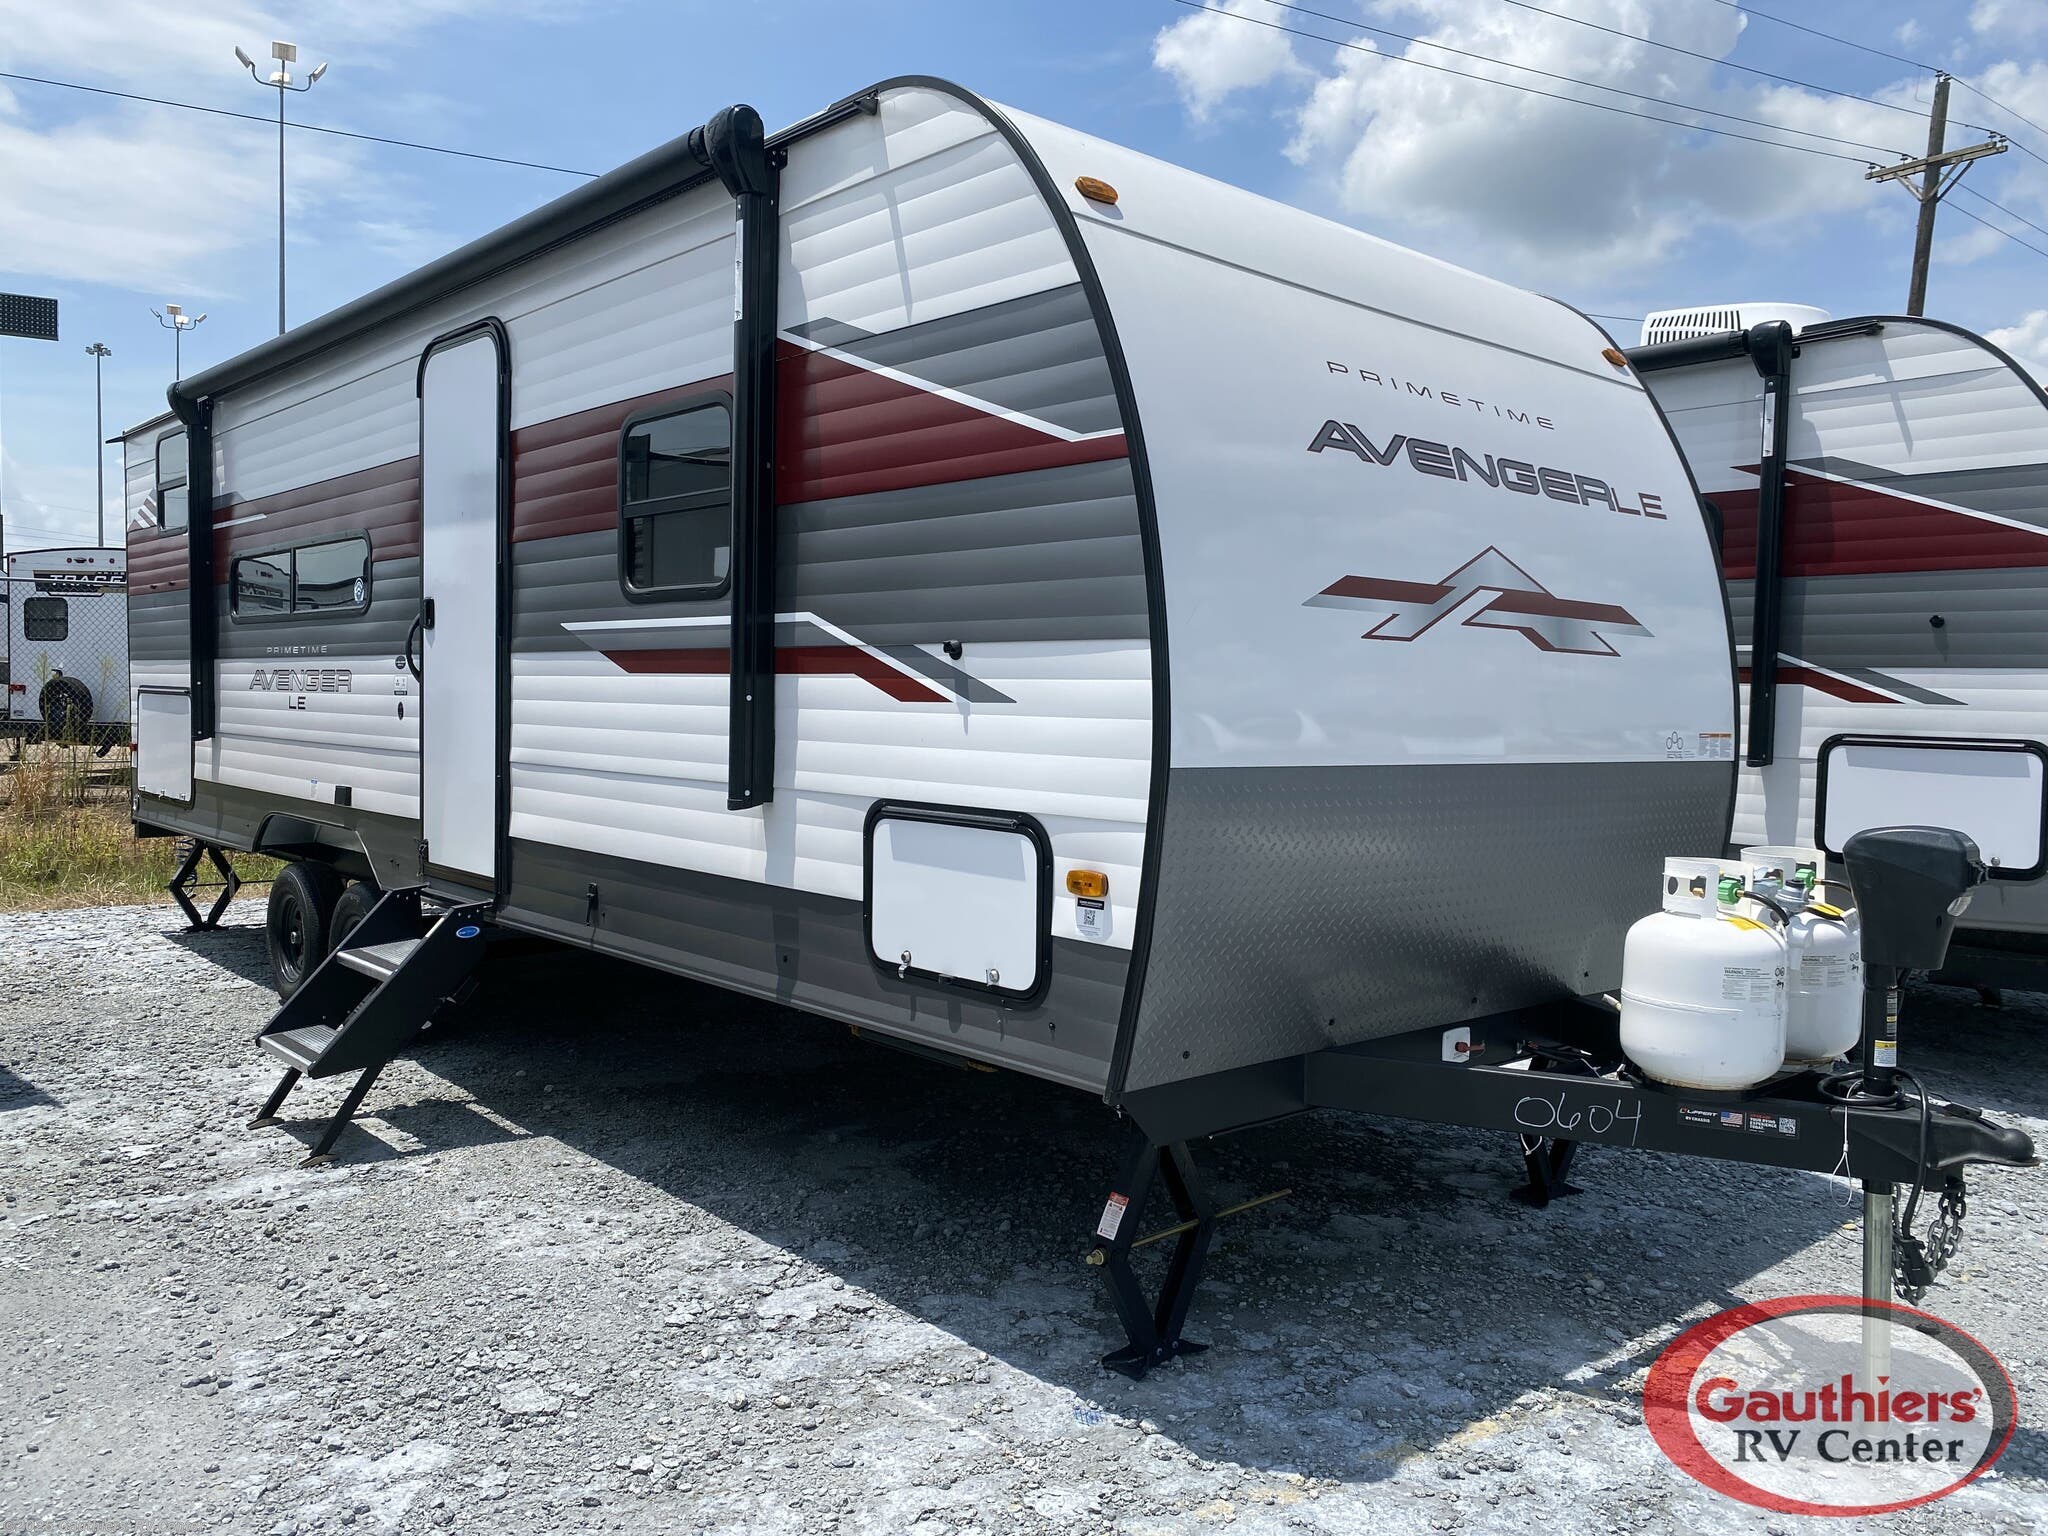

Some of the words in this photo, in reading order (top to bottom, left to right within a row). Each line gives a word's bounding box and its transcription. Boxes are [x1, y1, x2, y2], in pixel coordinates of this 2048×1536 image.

[1327, 361, 1554, 430] PRIMETIME
[1307, 420, 1616, 512] AVENGER
[1611, 487, 1668, 520] LE
[267, 646, 328, 654] PRIMETIME
[249, 669, 352, 692] AVENGER
[289, 696, 306, 710] LE
[1514, 1092, 1642, 1147] 0604
